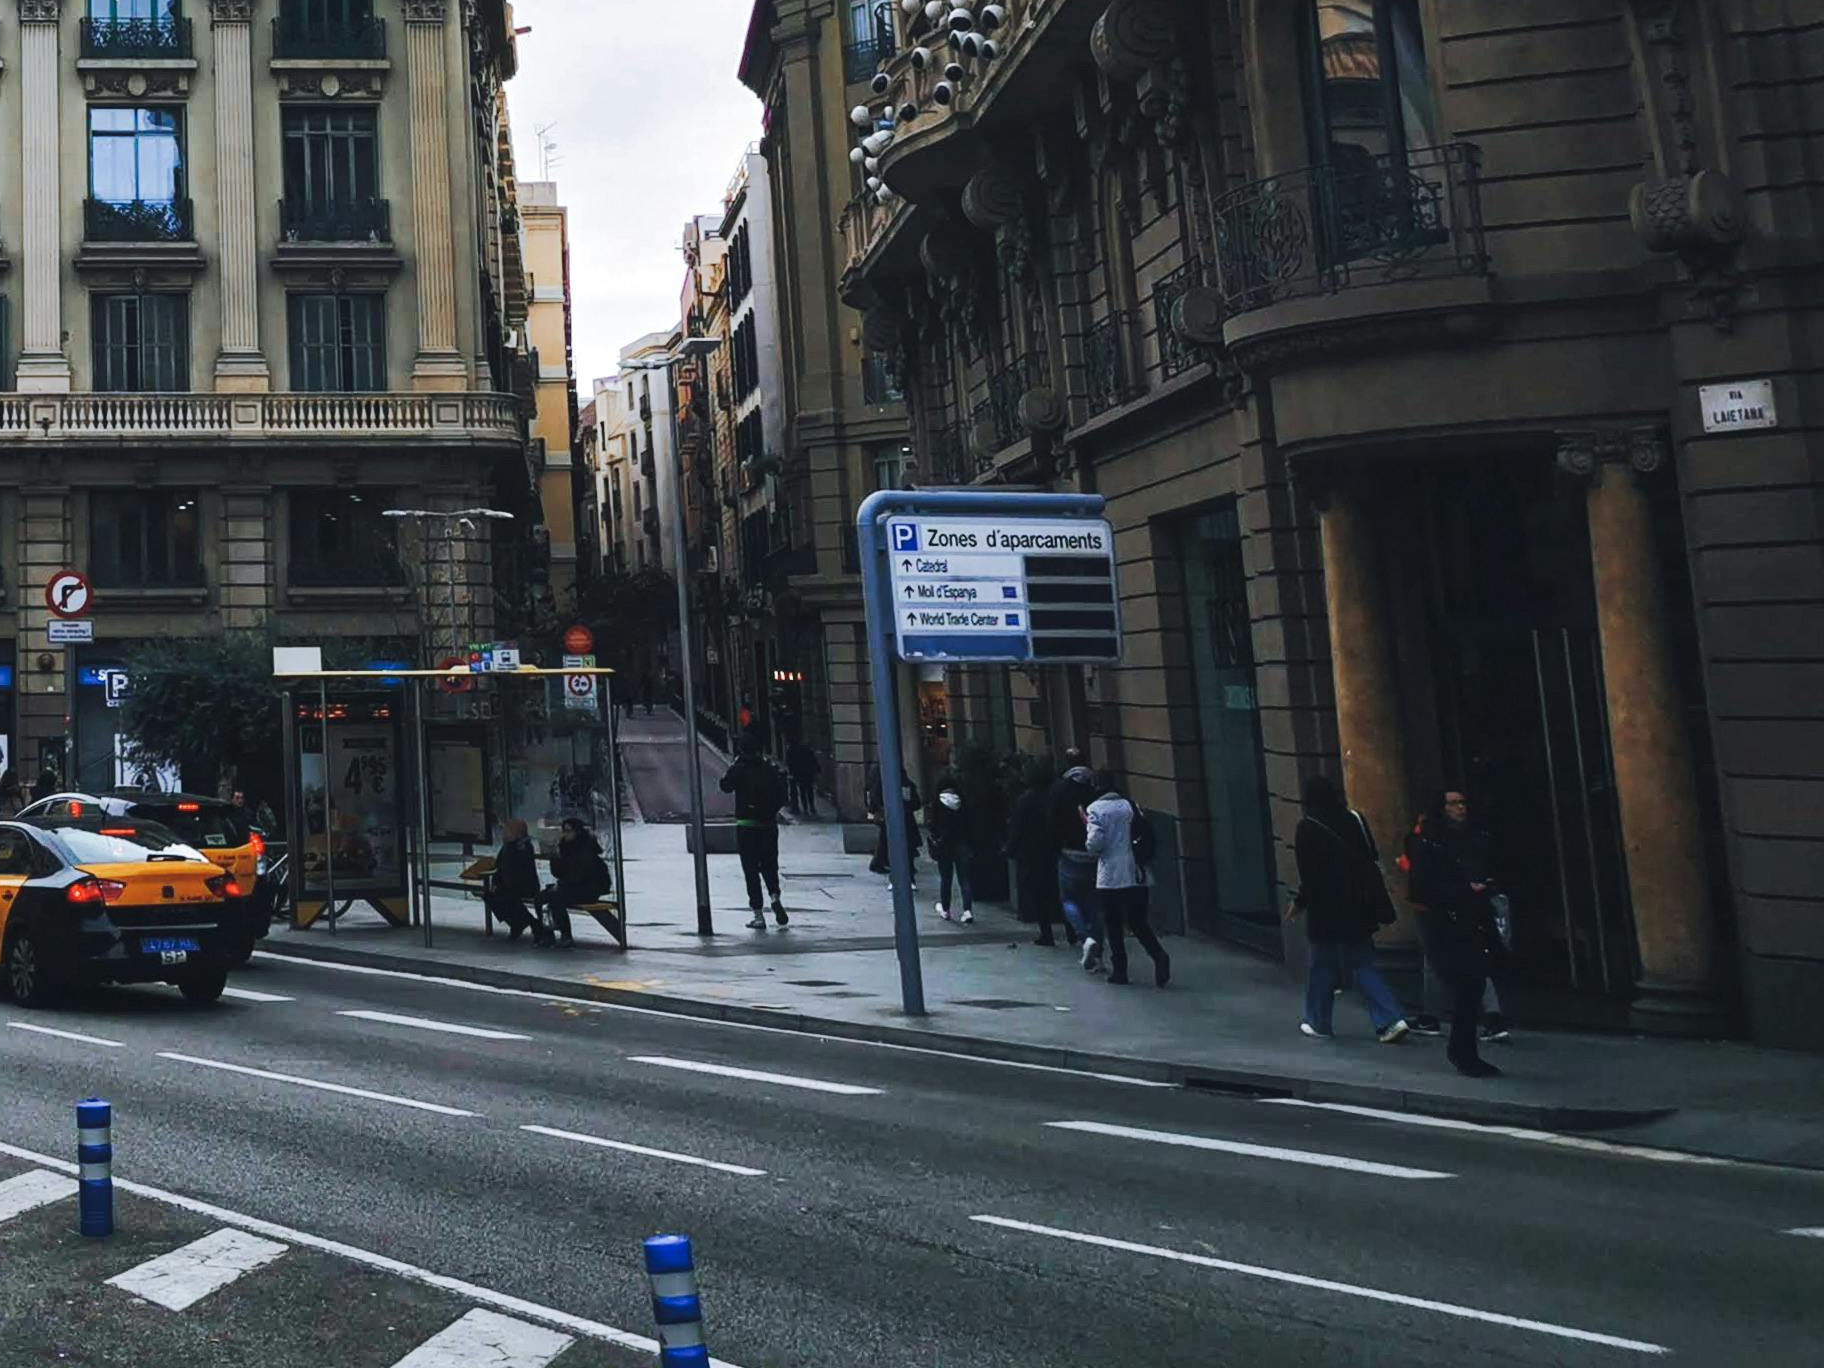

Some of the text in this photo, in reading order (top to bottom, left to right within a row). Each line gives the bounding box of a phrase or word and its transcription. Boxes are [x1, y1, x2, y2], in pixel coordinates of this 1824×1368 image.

[1713, 407, 1765, 424] LAIETANA
[894, 524, 1102, 551] P Zones d'aparcaments
[916, 559, 948, 573] Catedral
[918, 585, 977, 600] Moll d'Espanya
[920, 613, 998, 626] World Trade Center
